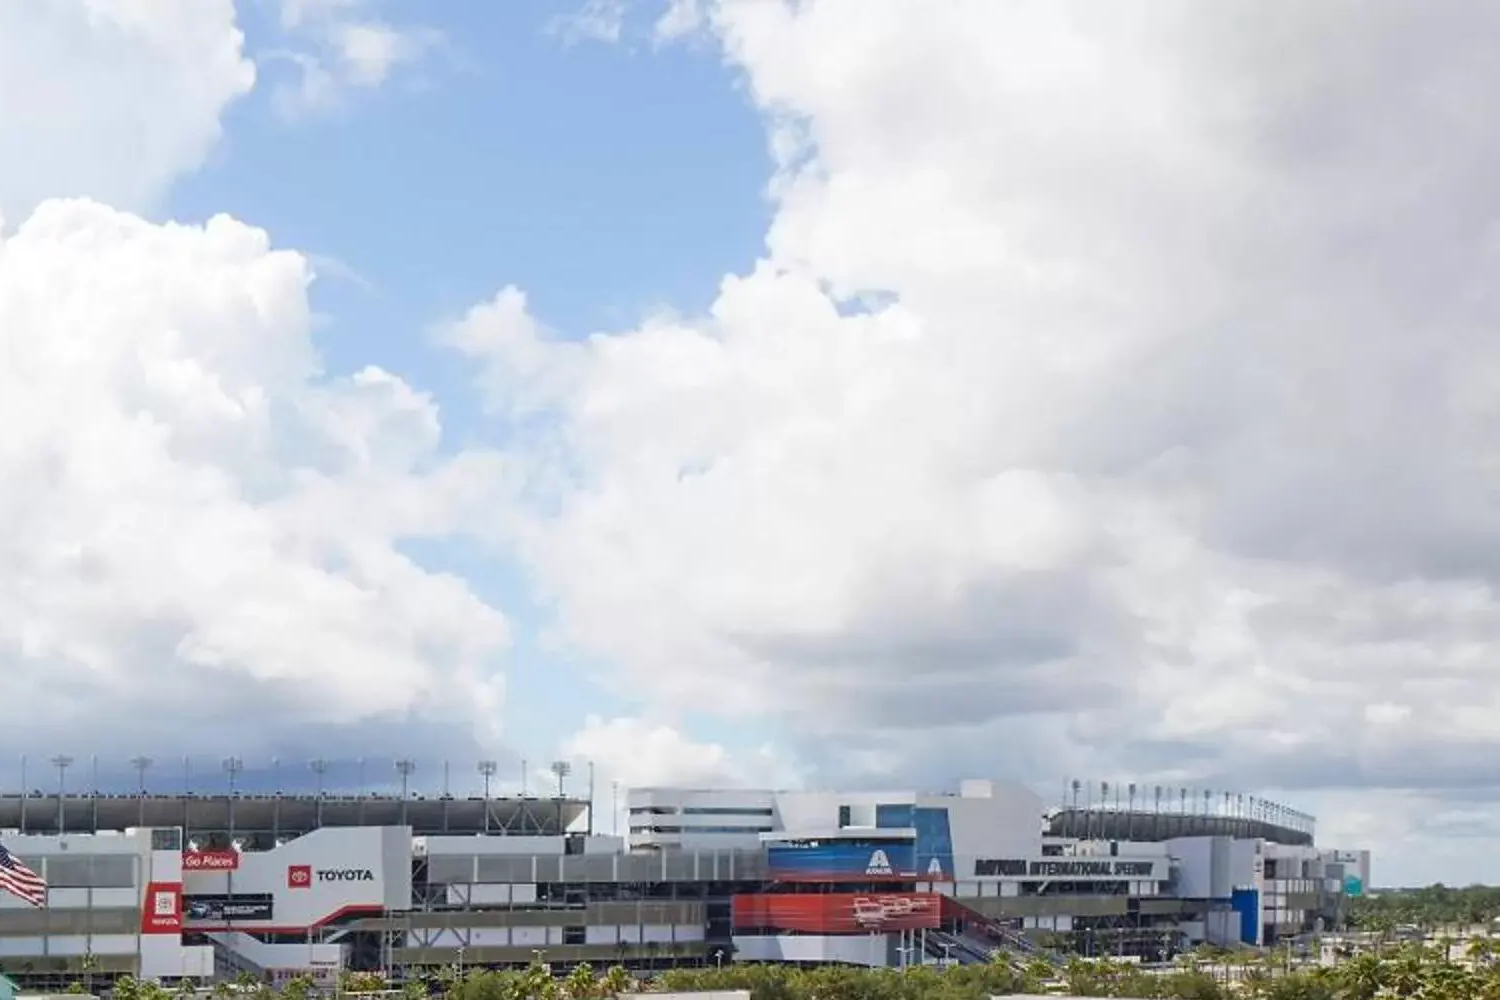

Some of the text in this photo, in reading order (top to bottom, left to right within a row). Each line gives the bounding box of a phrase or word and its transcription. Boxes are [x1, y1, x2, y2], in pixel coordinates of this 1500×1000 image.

[186, 855, 201, 866] Go
[1030, 861, 1112, 876] INTERNATIONAL
[1114, 862, 1154, 875] SPEEDWAY
[317, 869, 374, 881] TOYOTA
